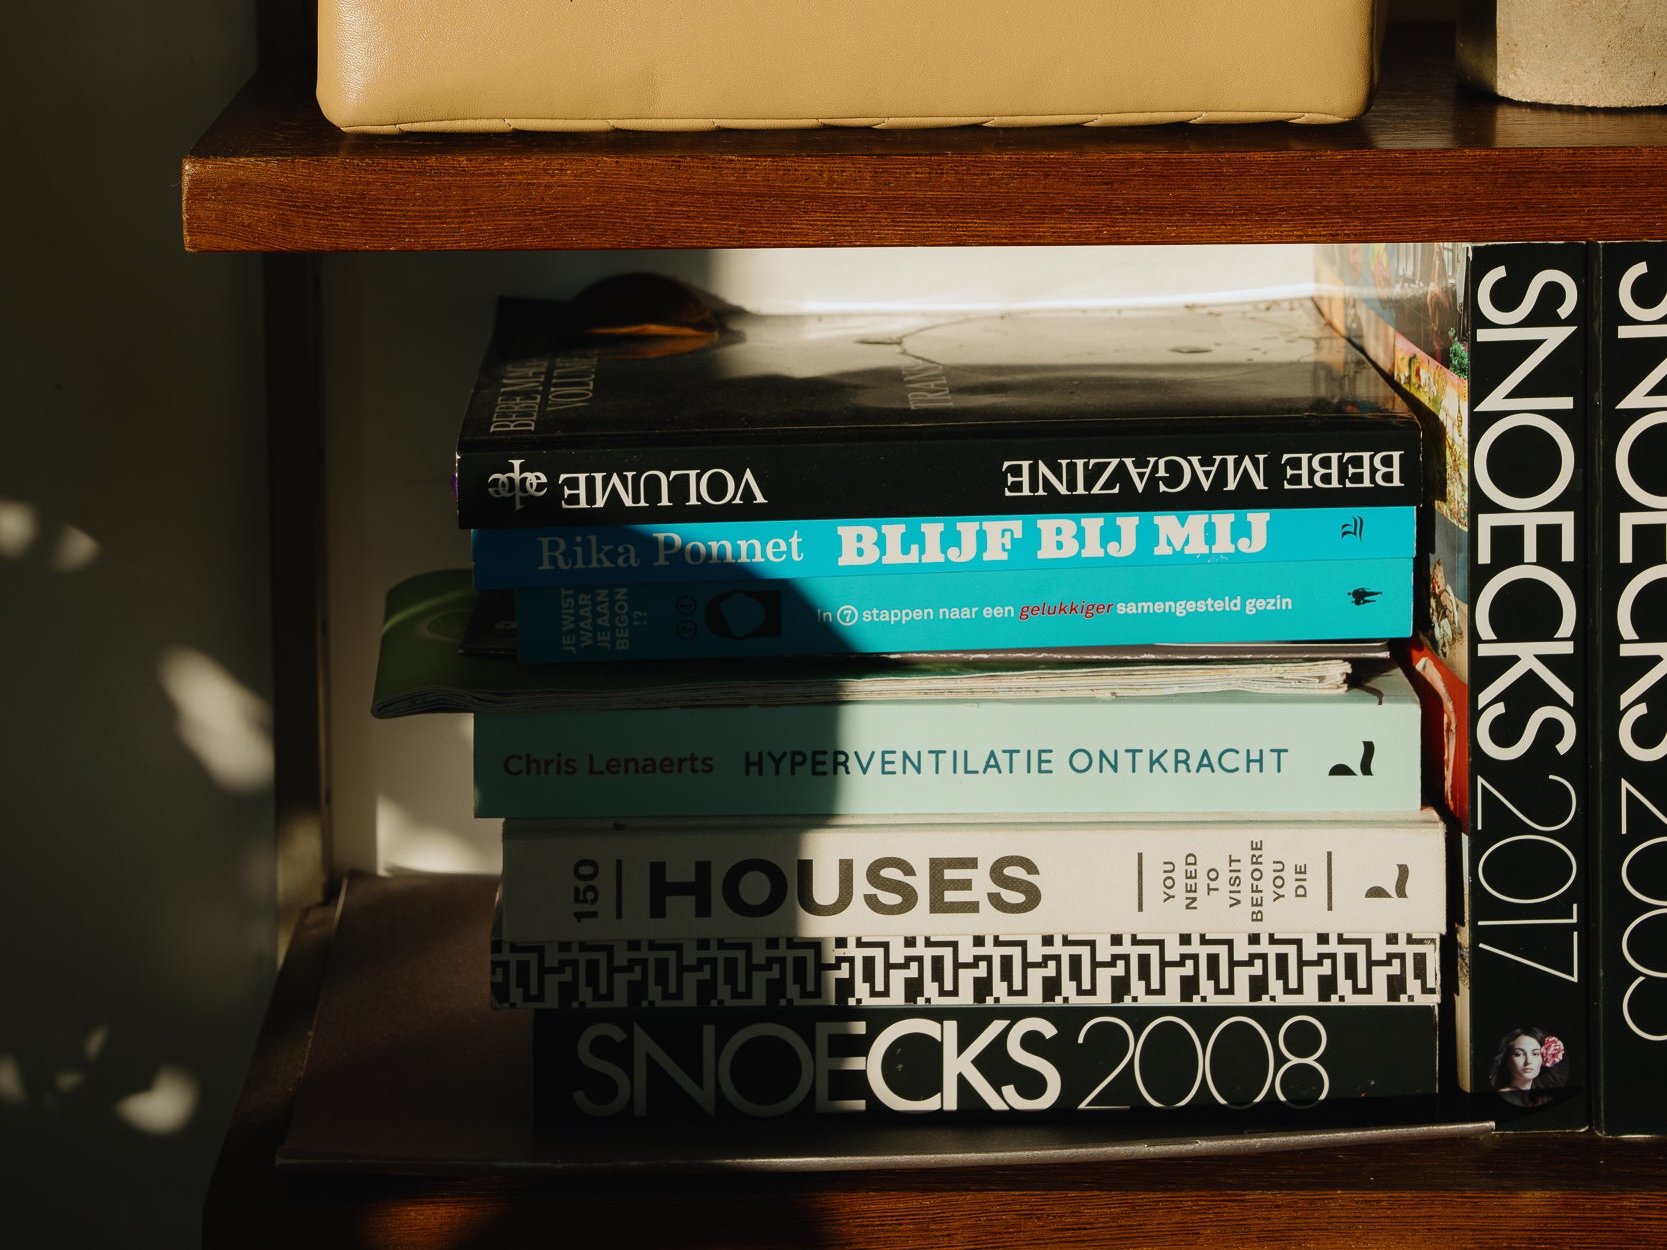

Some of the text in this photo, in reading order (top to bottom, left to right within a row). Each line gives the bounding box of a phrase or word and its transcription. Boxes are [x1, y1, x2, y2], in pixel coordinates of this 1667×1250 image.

[489, 393, 542, 434] BEBE
[558, 467, 768, 509] VOLUME
[1002, 451, 1405, 497] BEBE MAGAZINE
[536, 529, 804, 571] Rika Ponnet
[836, 512, 1271, 567] BLIJF BIJ MIJ
[560, 587, 577, 654] JE WIST
[578, 593, 594, 648] WAAR
[596, 588, 612, 650] JE AAN
[614, 587, 630, 650] BEGON
[817, 608, 833, 623] In
[862, 607, 934, 625] stappen
[939, 606, 979, 620] naar
[982, 603, 1015, 619] een
[1018, 600, 1114, 621] gelukkiger
[1116, 596, 1241, 620] samengesteld
[1246, 595, 1293, 614] gezin
[1473, 265, 1579, 984] SNOECKS 2017
[503, 748, 1289, 777] Chris Lenaerts HYPERVENTILATIE ONTKRACHT
[572, 858, 600, 923] 150
[649, 855, 1042, 919] HOUSES
[1163, 860, 1176, 903] YOU
[1184, 852, 1198, 910] NEED
[1206, 867, 1220, 896] TO
[1228, 854, 1242, 909] VISIT
[1250, 839, 1264, 923] BEFORE
[1272, 859, 1286, 902] YOU
[1294, 862, 1308, 898] DIE
[572, 1015, 1330, 1117] SNOECKS 2008
